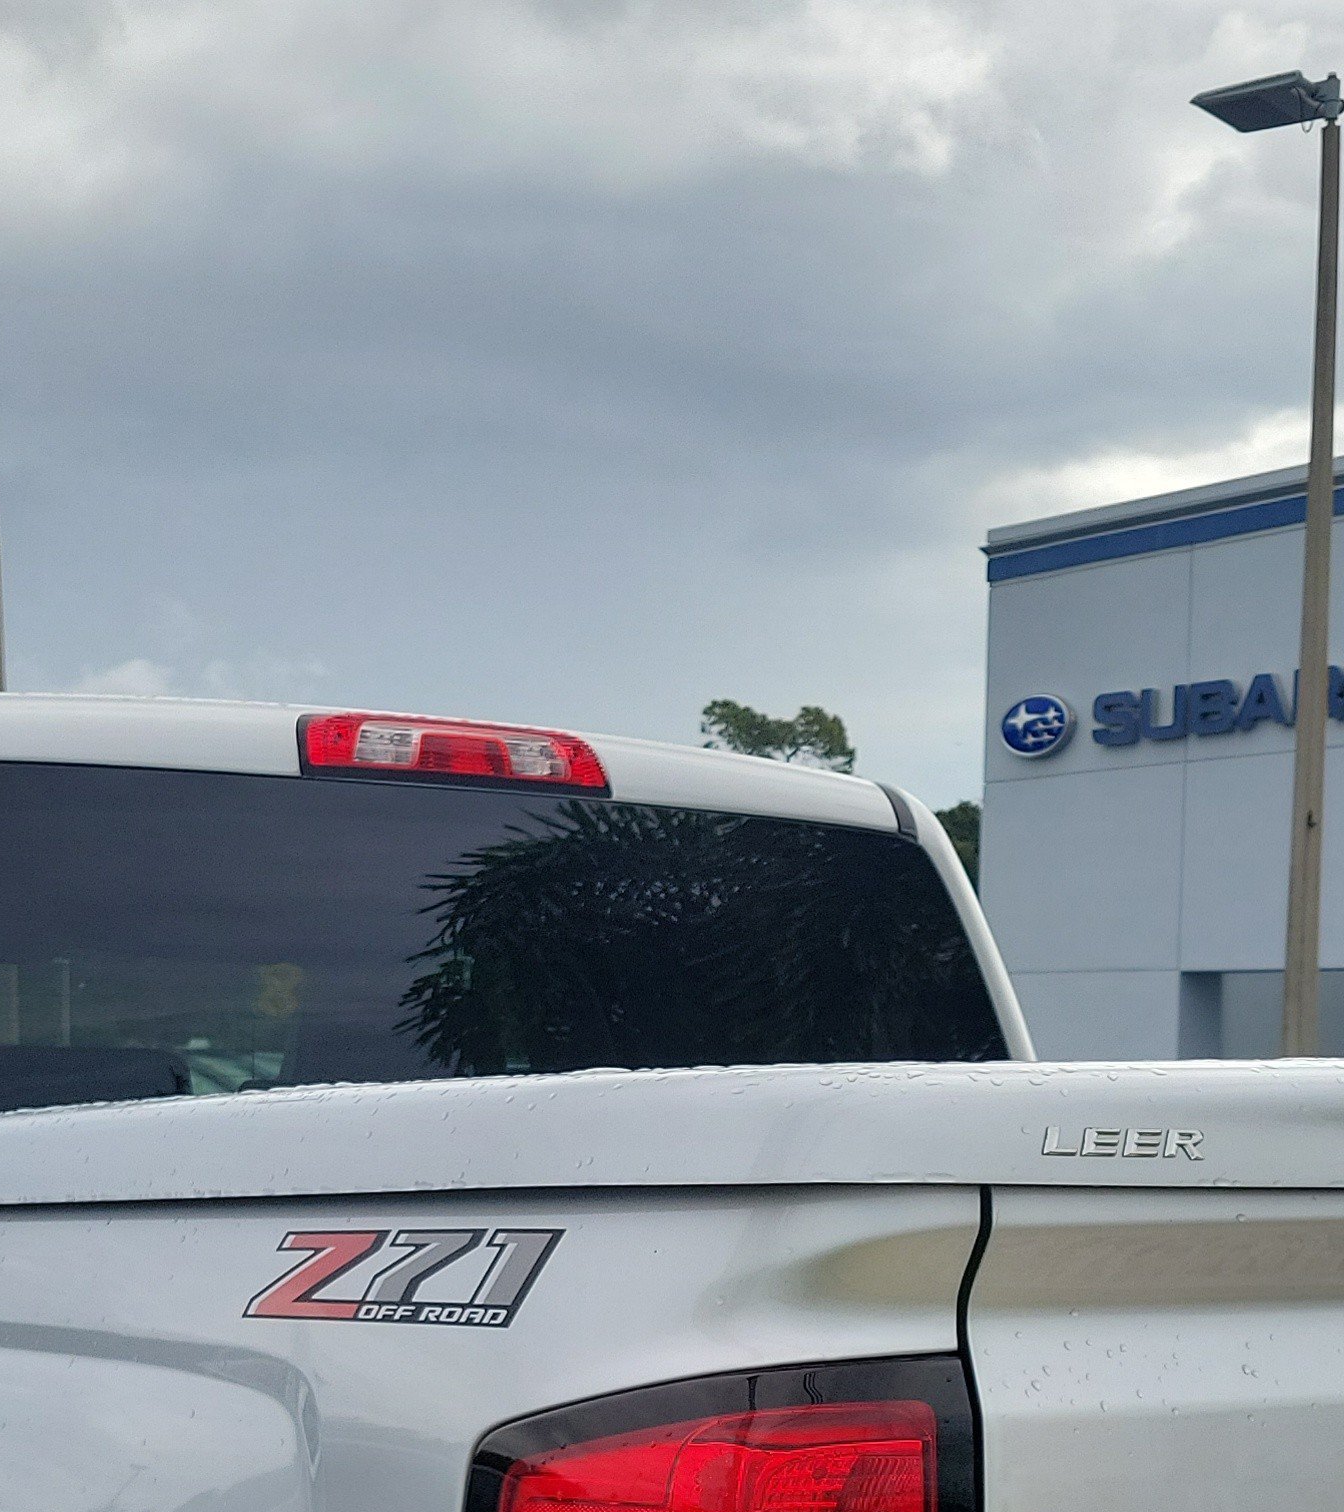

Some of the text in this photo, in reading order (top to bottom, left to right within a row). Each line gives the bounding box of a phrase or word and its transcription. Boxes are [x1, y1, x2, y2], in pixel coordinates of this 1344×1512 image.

[1042, 1125, 1206, 1160] LEER
[243, 1228, 567, 1323] Z71
[357, 1304, 508, 1325] OFF ROAD
